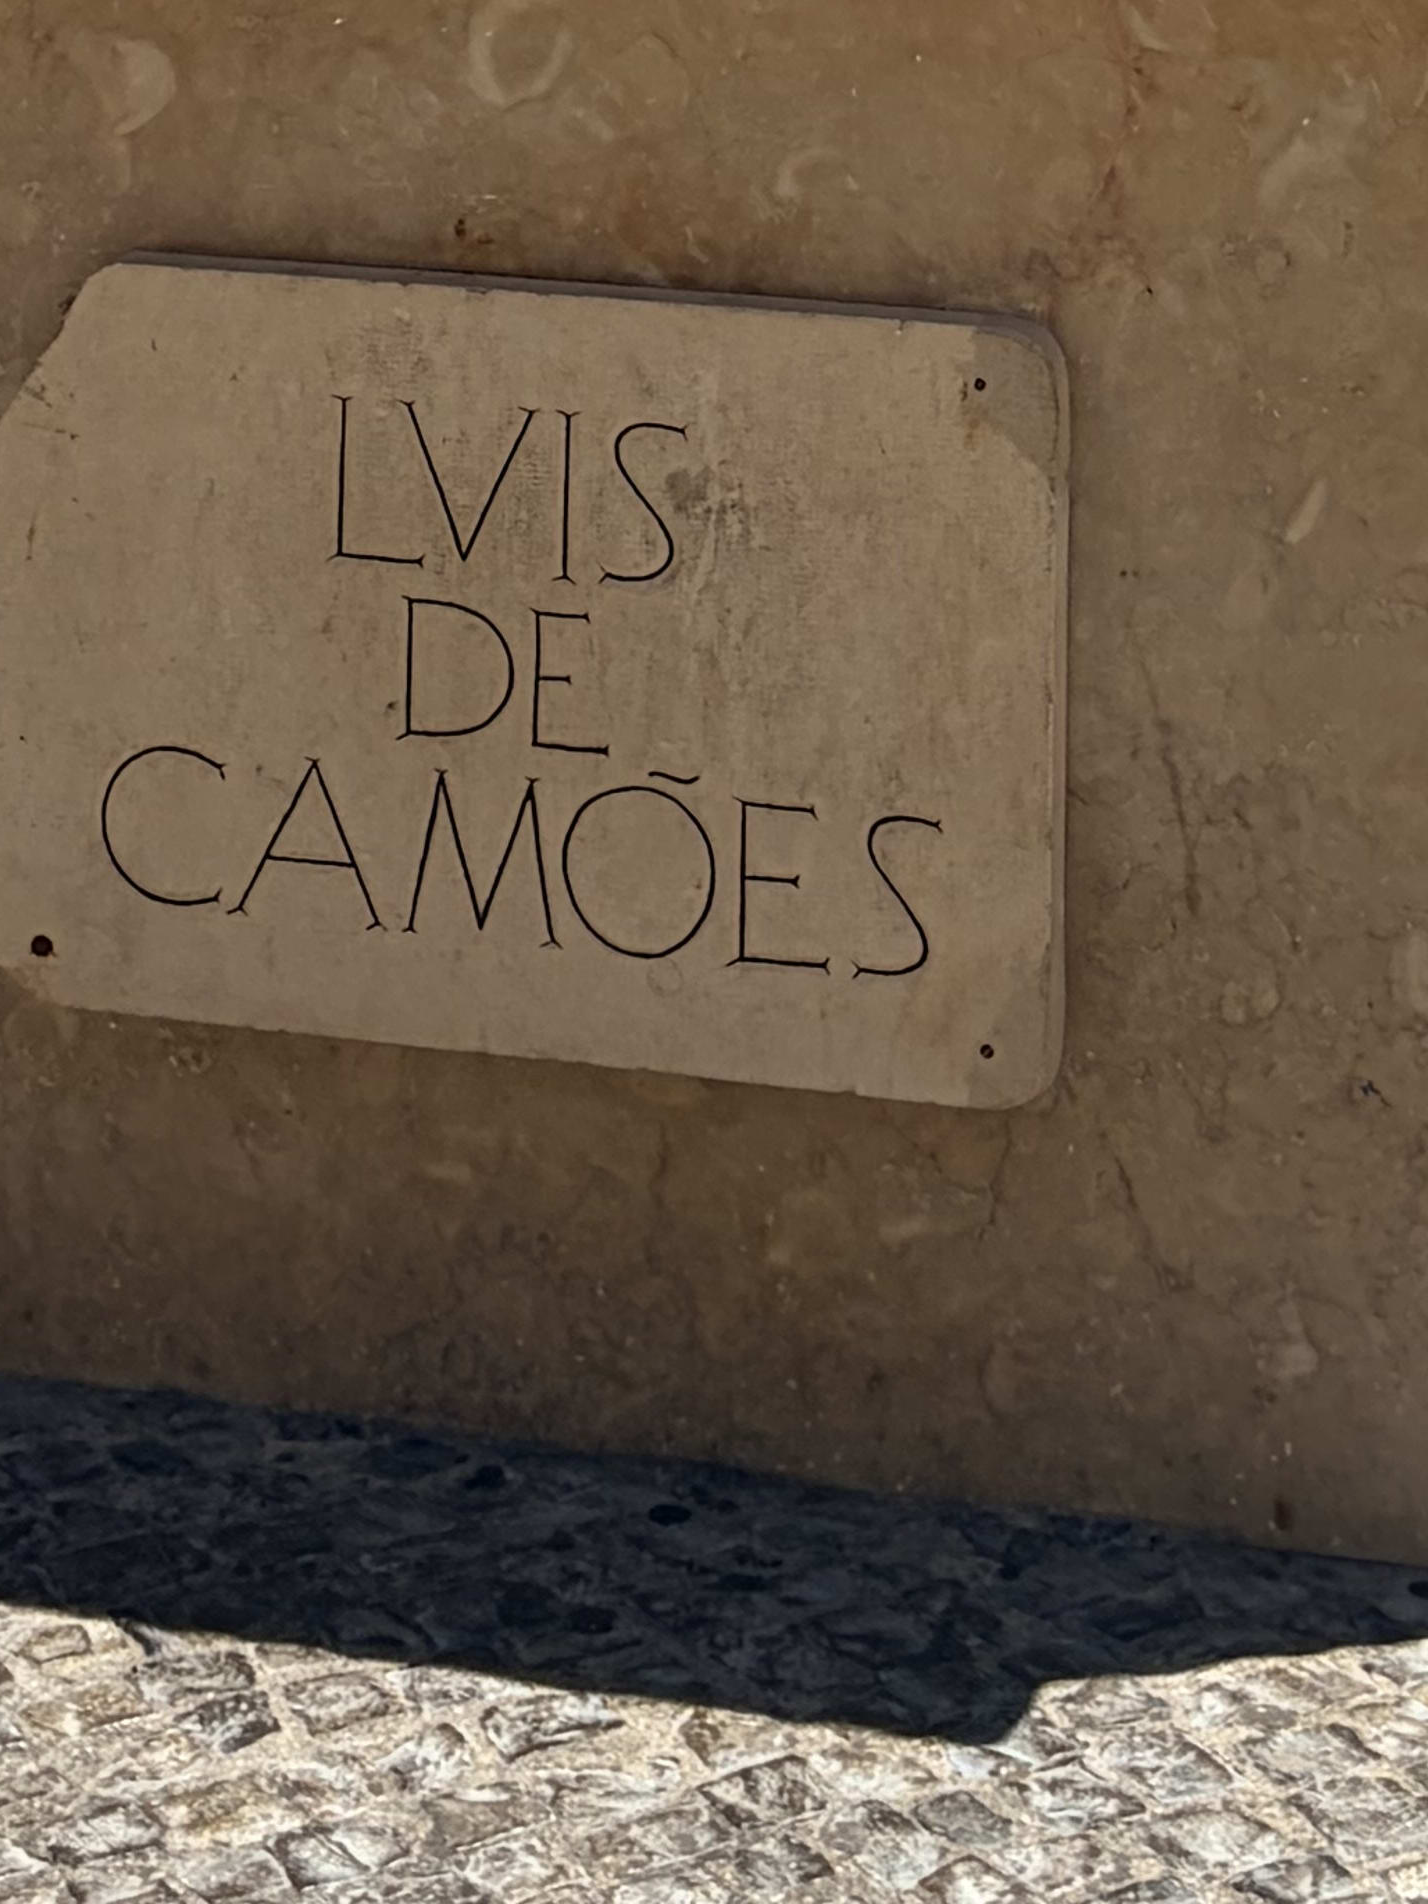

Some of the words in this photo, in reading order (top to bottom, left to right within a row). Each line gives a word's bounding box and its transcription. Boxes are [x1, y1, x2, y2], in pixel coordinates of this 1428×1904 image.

[327, 395, 688, 584] LVIS
[398, 596, 608, 756] DE
[101, 746, 943, 979] CAMÕES
